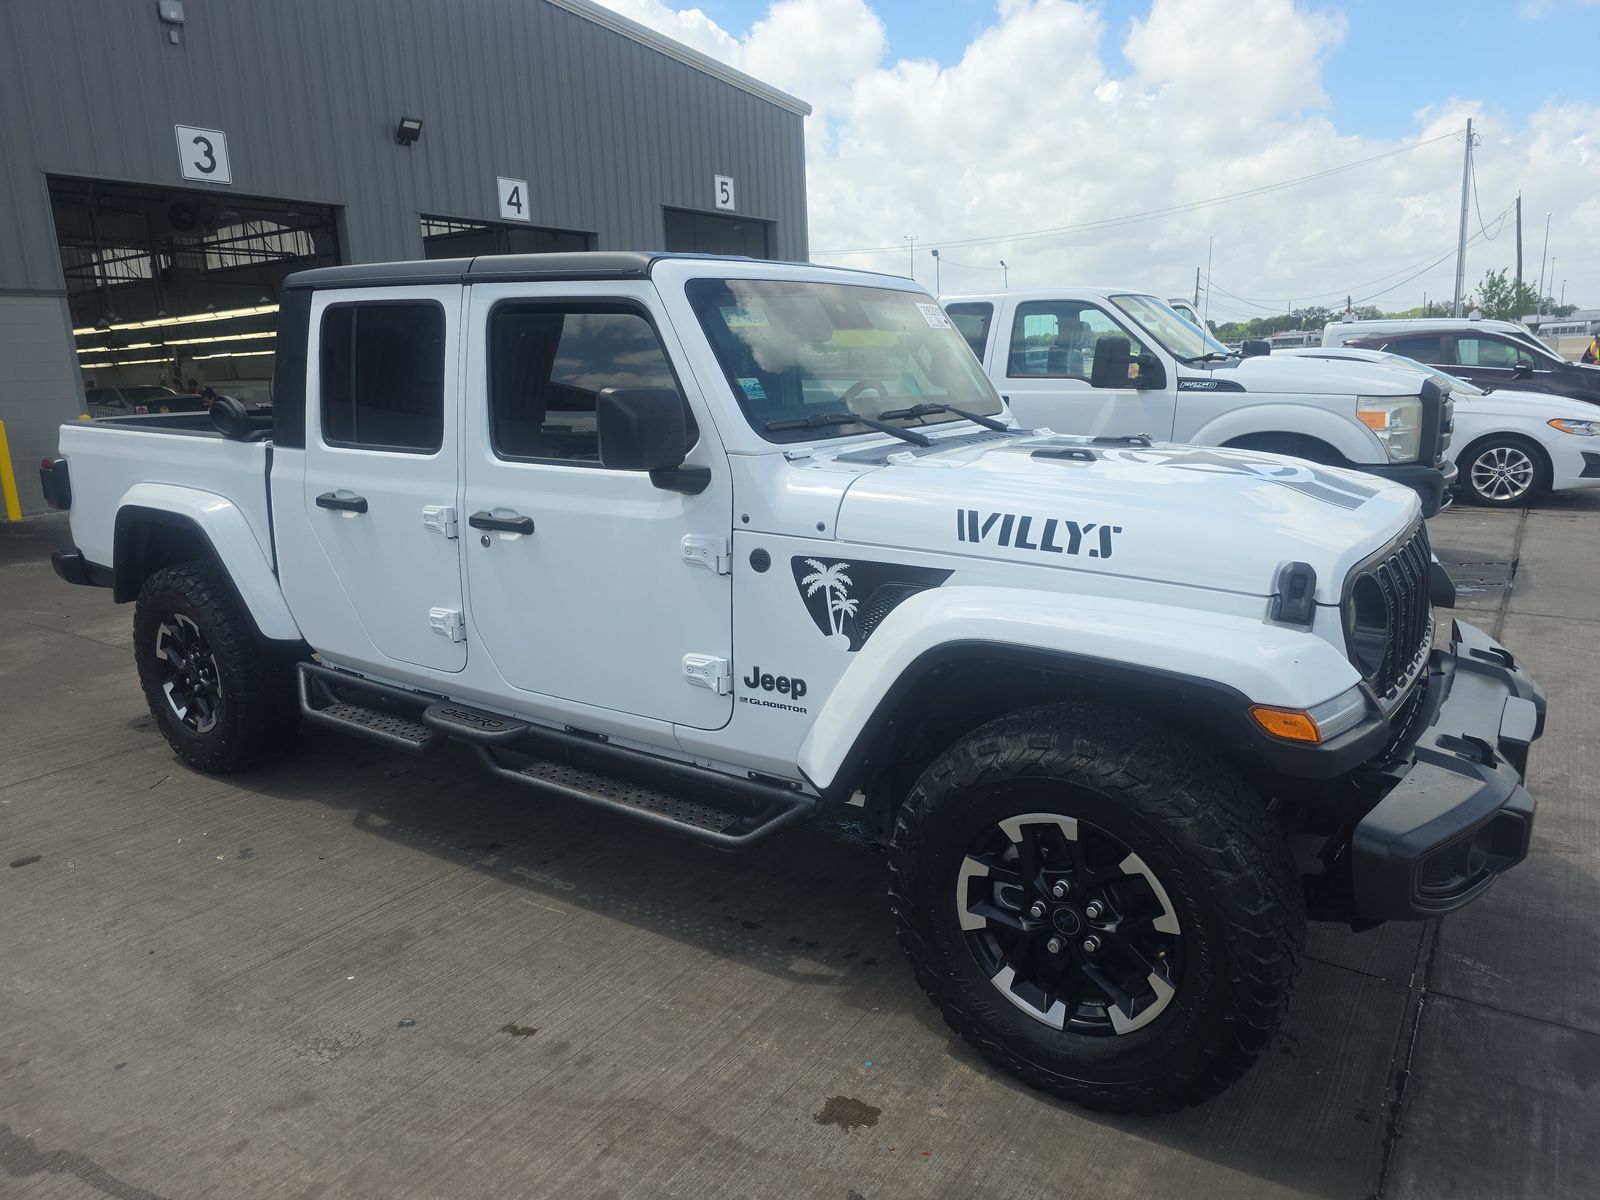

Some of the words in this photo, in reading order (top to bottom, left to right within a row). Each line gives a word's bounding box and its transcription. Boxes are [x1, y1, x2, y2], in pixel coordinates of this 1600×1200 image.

[192, 136, 217, 174] 3
[506, 186, 523, 214] 4
[720, 181, 729, 204] 5
[957, 509, 1123, 559] WILLYS
[743, 666, 807, 700] Jeep
[749, 697, 808, 714] GLADIATOR
